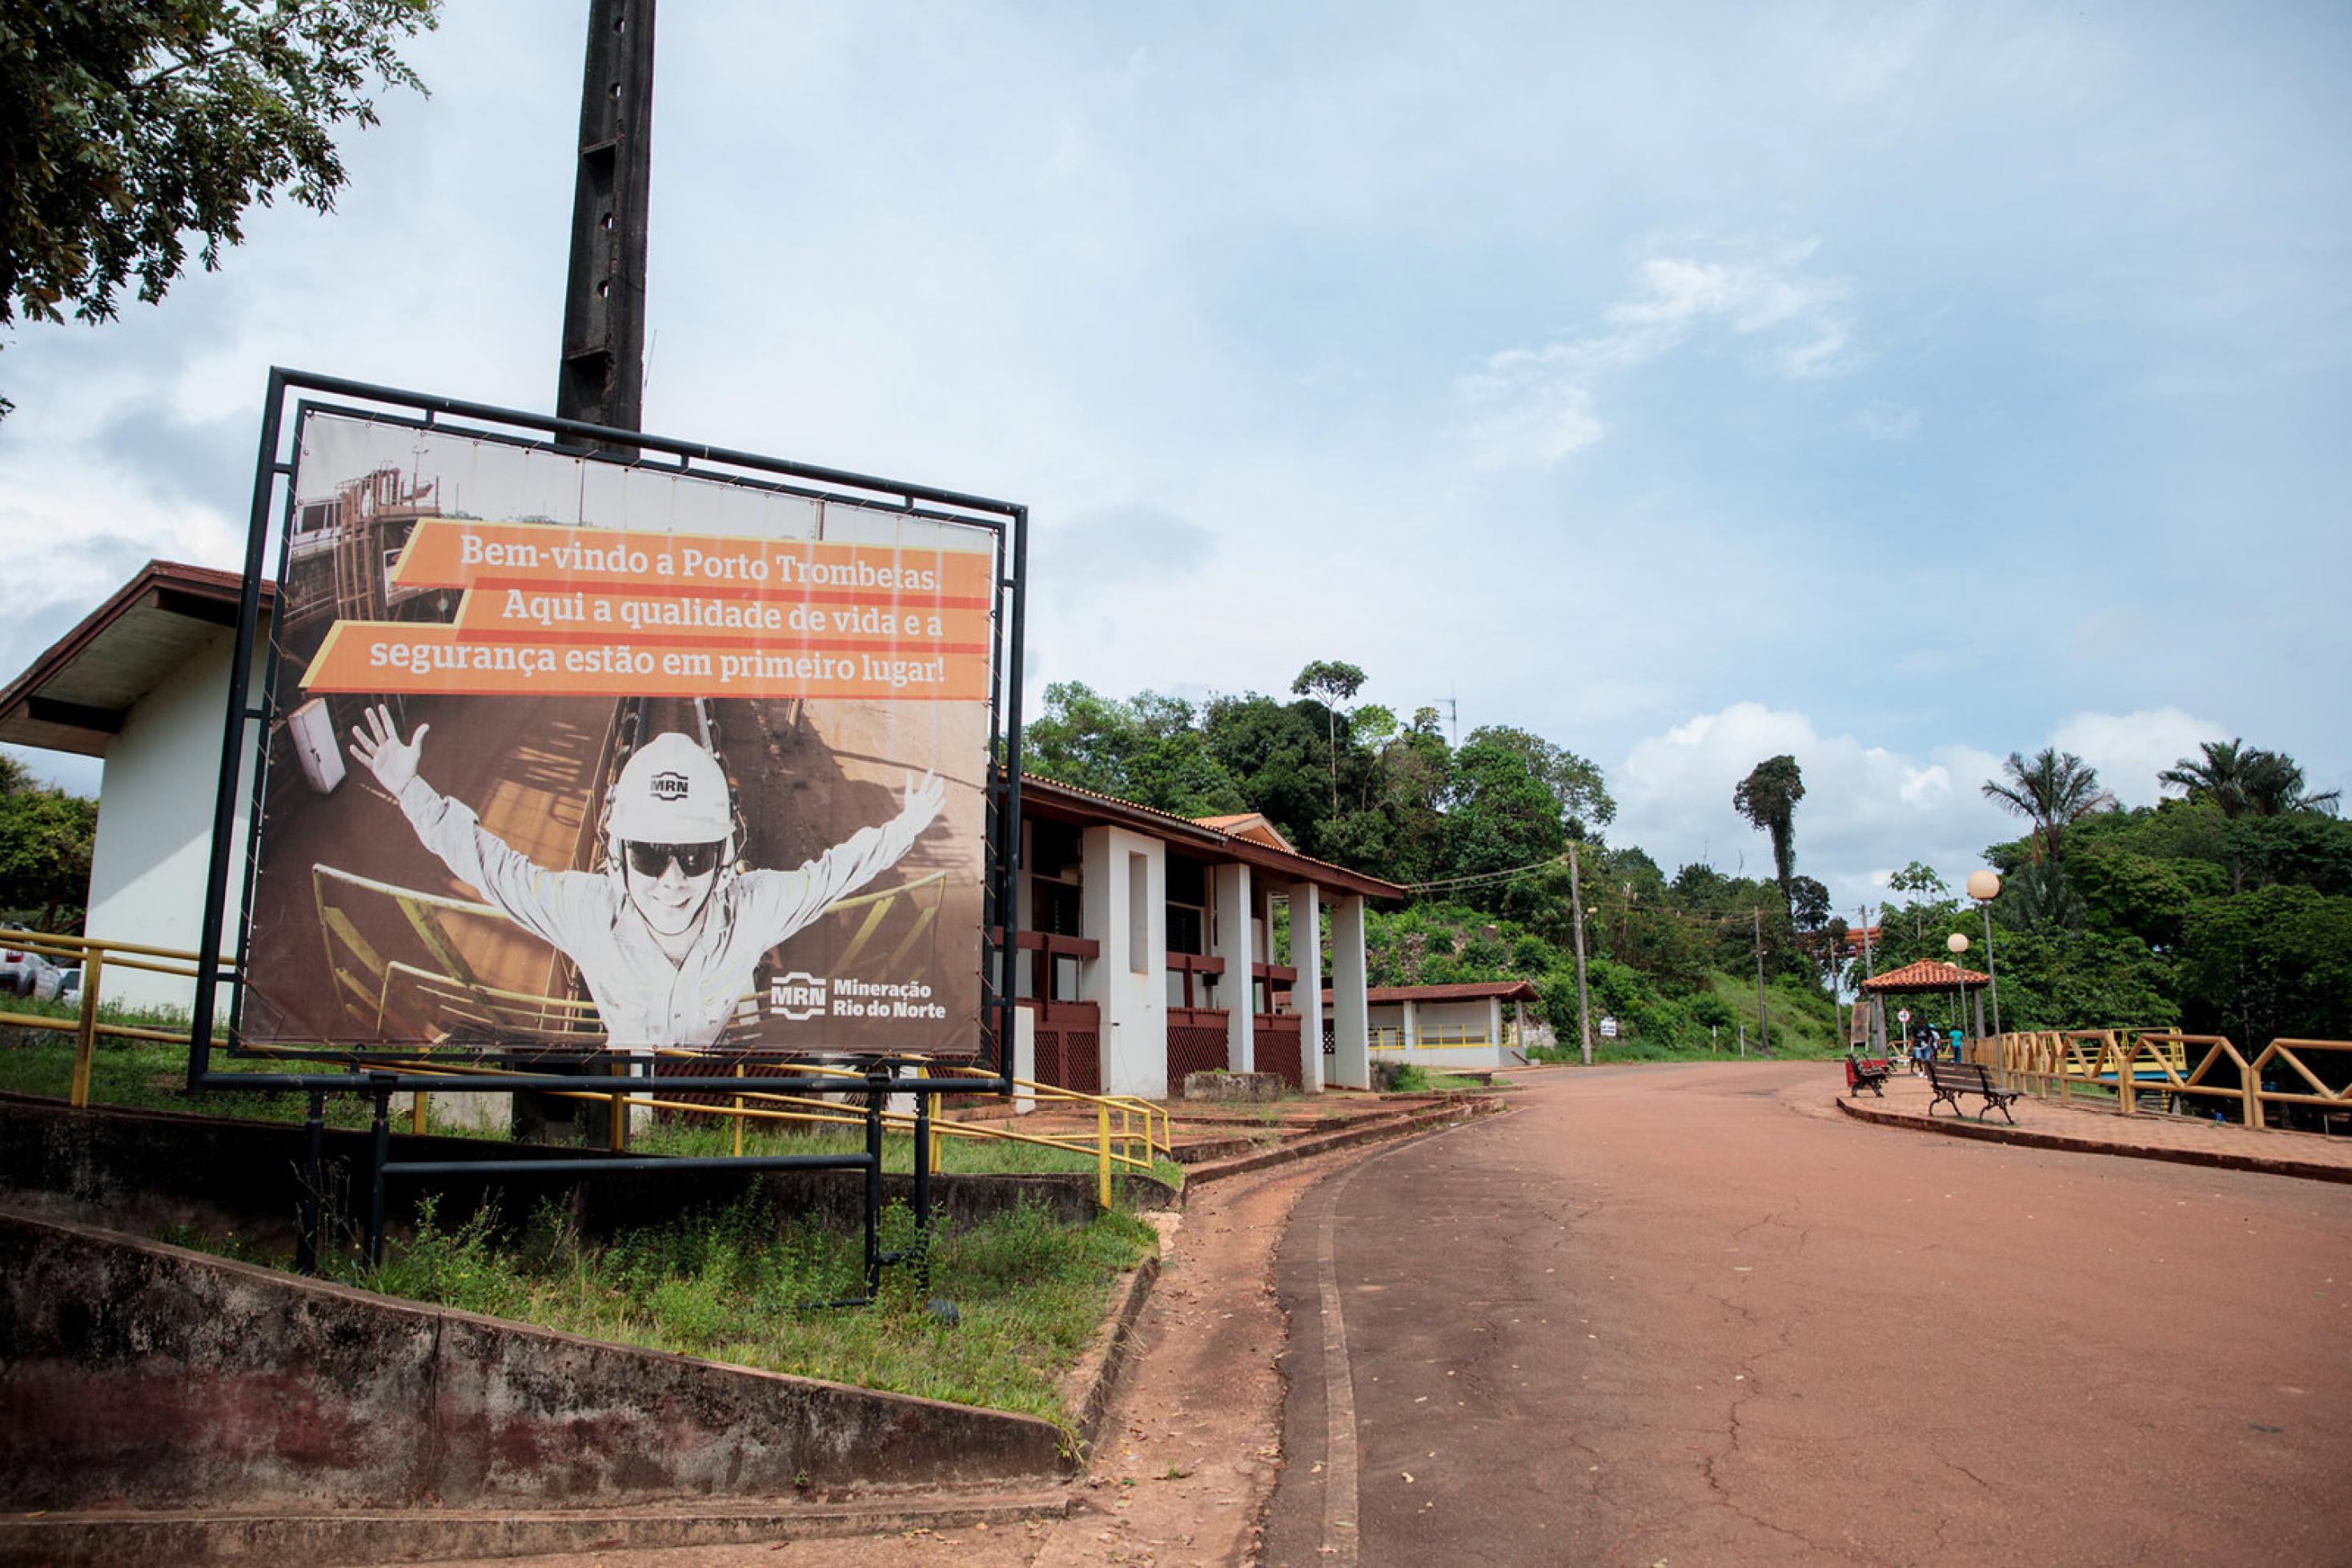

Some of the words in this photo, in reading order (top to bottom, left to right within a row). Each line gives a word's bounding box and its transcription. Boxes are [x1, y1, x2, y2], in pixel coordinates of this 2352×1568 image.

[461, 535, 649, 573] Bem-vindo
[656, 553, 675, 575] a
[682, 549, 769, 580] Porto
[776, 555, 941, 590] Trombetas.
[502, 589, 585, 625] Aqui
[593, 599, 612, 621] a
[620, 598, 781, 630] qualidade
[789, 604, 825, 631] de
[833, 606, 897, 635] vida
[905, 615, 921, 636] e
[927, 616, 943, 636] a
[370, 643, 556, 677] segurança
[565, 645, 654, 674] estão
[663, 652, 712, 676] em
[720, 650, 855, 683] primeiro
[862, 655, 945, 688] lugar!
[651, 780, 688, 792] MRN
[771, 986, 826, 1006] MRN
[833, 979, 931, 1000] Mineração
[833, 1000, 864, 1016] Rio
[866, 1001, 889, 1017] do
[893, 1002, 946, 1019] Norte
